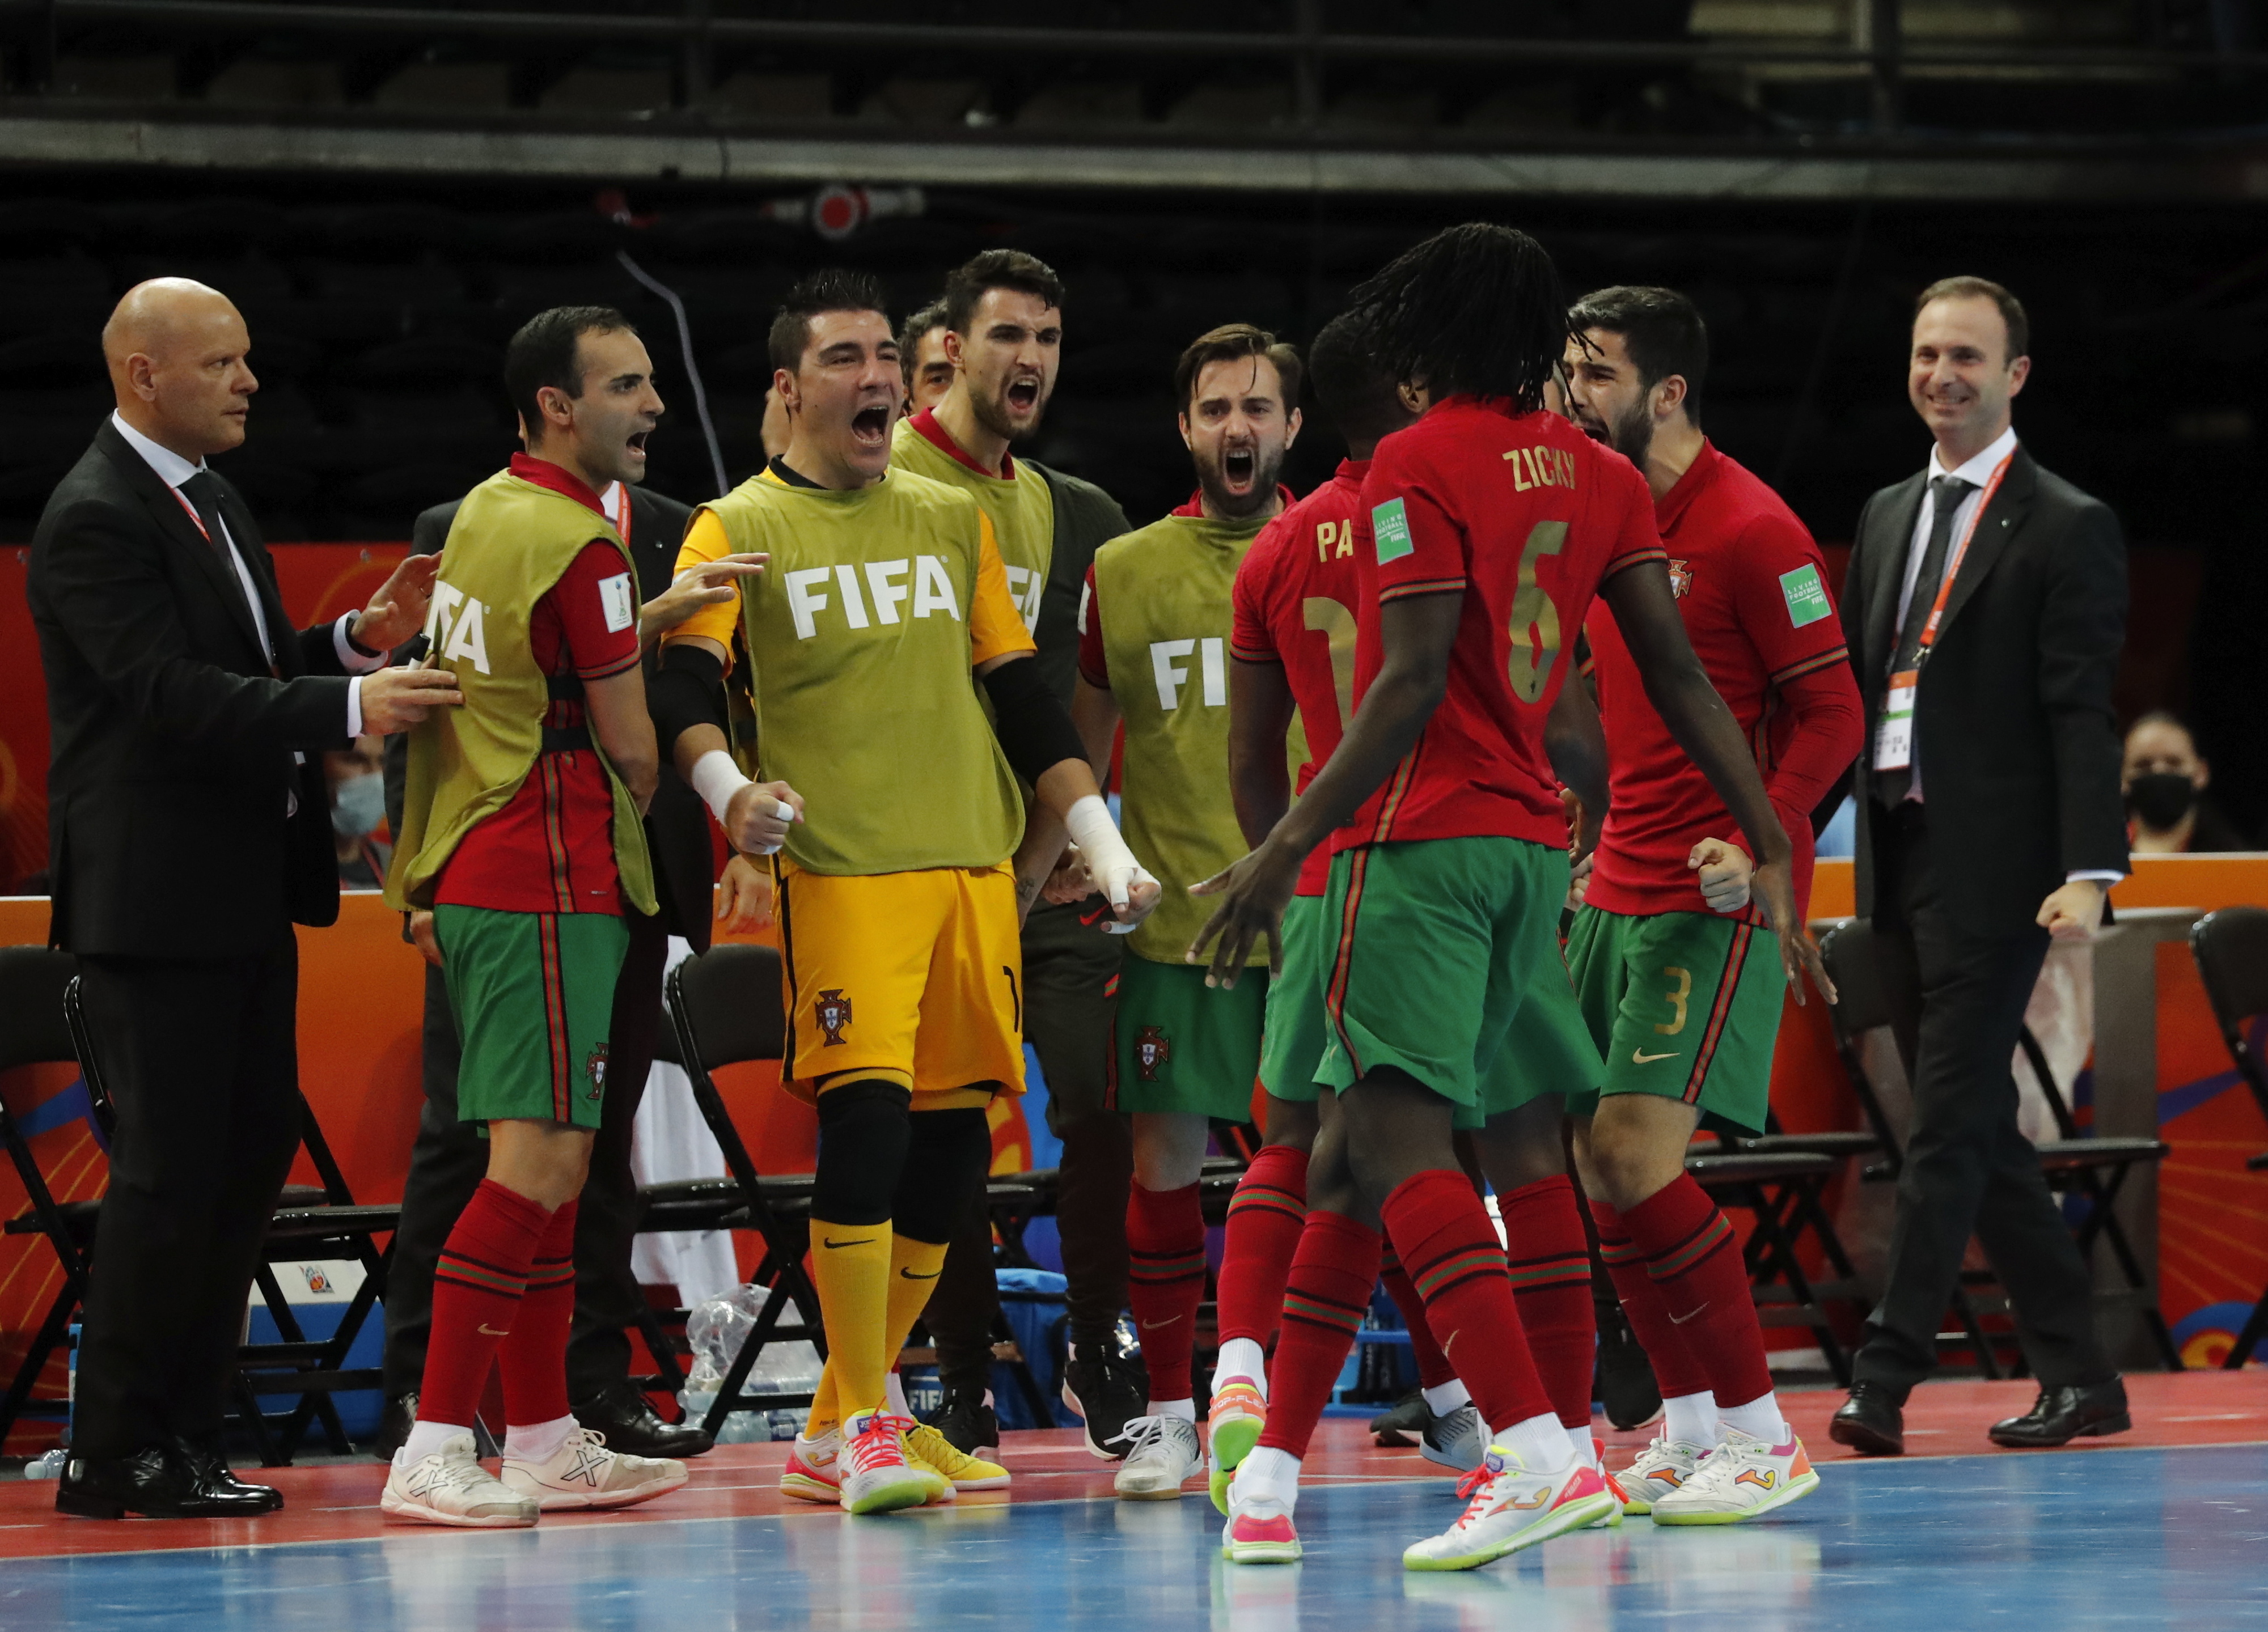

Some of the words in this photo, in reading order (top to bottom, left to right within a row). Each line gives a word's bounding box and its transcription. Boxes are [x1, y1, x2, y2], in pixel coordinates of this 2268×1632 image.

[1503, 445, 1575, 492] ZICKY
[784, 555, 960, 640] FIFA
[1508, 520, 1569, 703] 6
[1788, 578, 1817, 595] LIVING
[1789, 584, 1819, 600] FOOTBALL
[1811, 595, 1824, 605] FIFA
[1149, 637, 1226, 710] FI
[1654, 967, 1691, 1035] 3
